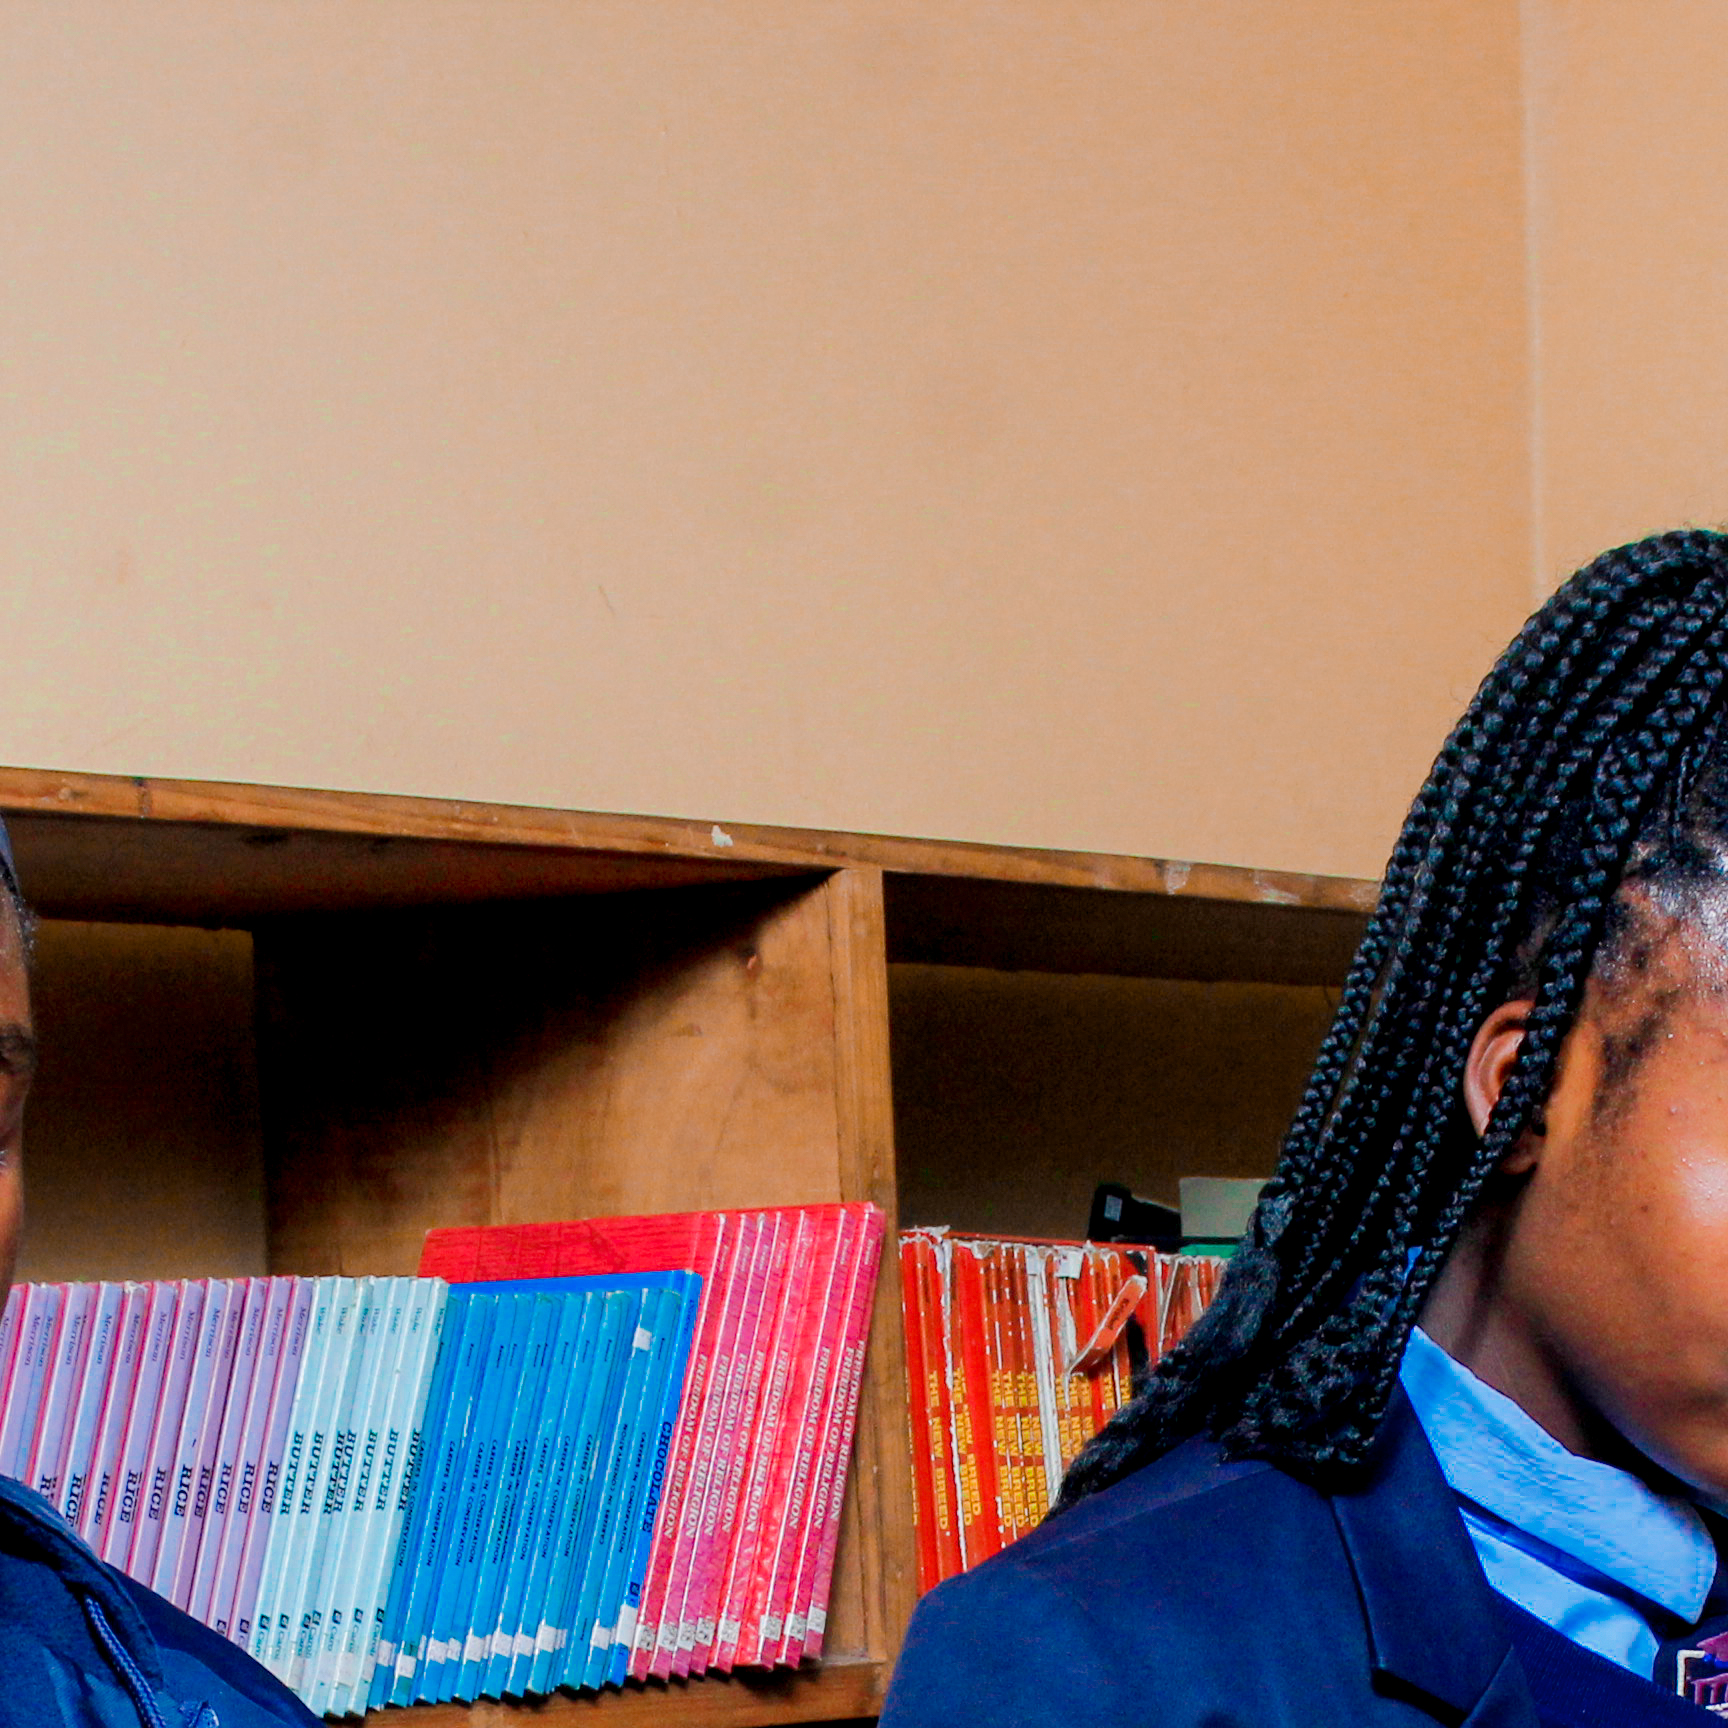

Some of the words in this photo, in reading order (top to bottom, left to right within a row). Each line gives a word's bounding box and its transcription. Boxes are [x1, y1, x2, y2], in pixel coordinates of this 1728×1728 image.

[685, 1353, 708, 1433] FREEDOM
[706, 1354, 730, 1433] FREEDOM
[725, 1352, 747, 1432] FREEDOM
[742, 1349, 765, 1428] FREEDOM
[767, 1349, 789, 1428] FREEDOM
[807, 1345, 831, 1425] FREEDOM
[832, 1346, 855, 1425] FREEDOM
[845, 1339, 866, 1418] FREEDOM
[928, 1370, 940, 1407] THE
[992, 1369, 1002, 1407] THE
[1003, 1370, 1014, 1407] THE
[1017, 1371, 1027, 1408] THE
[1028, 1370, 1039, 1407] THE
[1104, 1372, 1115, 1409] THE
[681, 1434, 691, 1461] OF
[702, 1435, 713, 1461] OF
[721, 1433, 731, 1459] OF
[738, 1429, 749, 1456] OF
[762, 1429, 773, 1456] OF
[803, 1426, 815, 1452] OF
[827, 1426, 840, 1451] OF
[841, 1419, 853, 1444] OF
[932, 1416, 944, 1458] NEW
[956, 1412, 968, 1454] NEW
[995, 1415, 1006, 1456] NEW
[1006, 1416, 1019, 1457] NEW
[1021, 1416, 1032, 1457] NEW
[1032, 1415, 1044, 1457] NEW
[66, 1473, 83, 1527] RICE
[120, 1469, 139, 1524] RICE
[149, 1467, 167, 1521] RICE
[175, 1464, 193, 1517] RICE
[194, 1465, 211, 1519] RICE
[215, 1461, 232, 1514] RICE
[238, 1461, 256, 1513] RICE
[261, 1461, 279, 1513] RICE
[280, 1430, 304, 1516] BUTTER
[300, 1430, 324, 1515] BUTTER
[323, 1430, 346, 1515] BUTTER
[333, 1428, 358, 1513] BUTTER
[354, 1428, 378, 1513] BUTTER
[375, 1427, 400, 1512] BUTTER
[398, 1427, 422, 1512] BUTTER
[642, 1421, 672, 1533] CHOCOLATE
[664, 1459, 687, 1539] RELIGION
[686, 1459, 708, 1539] RELIGION
[704, 1457, 727, 1537] RELIGION
[722, 1454, 745, 1533] RELIGION
[746, 1453, 769, 1533] RELIGION
[789, 1450, 812, 1529] RELIGION
[813, 1450, 836, 1529] RELIGION
[829, 1442, 850, 1521] RELIGION
[935, 1467, 948, 1530] BREED
[960, 1463, 973, 1526] BREED
[1000, 1465, 1012, 1528] BREED
[1012, 1466, 1025, 1528] BREED
[1025, 1466, 1040, 1528] BREED
